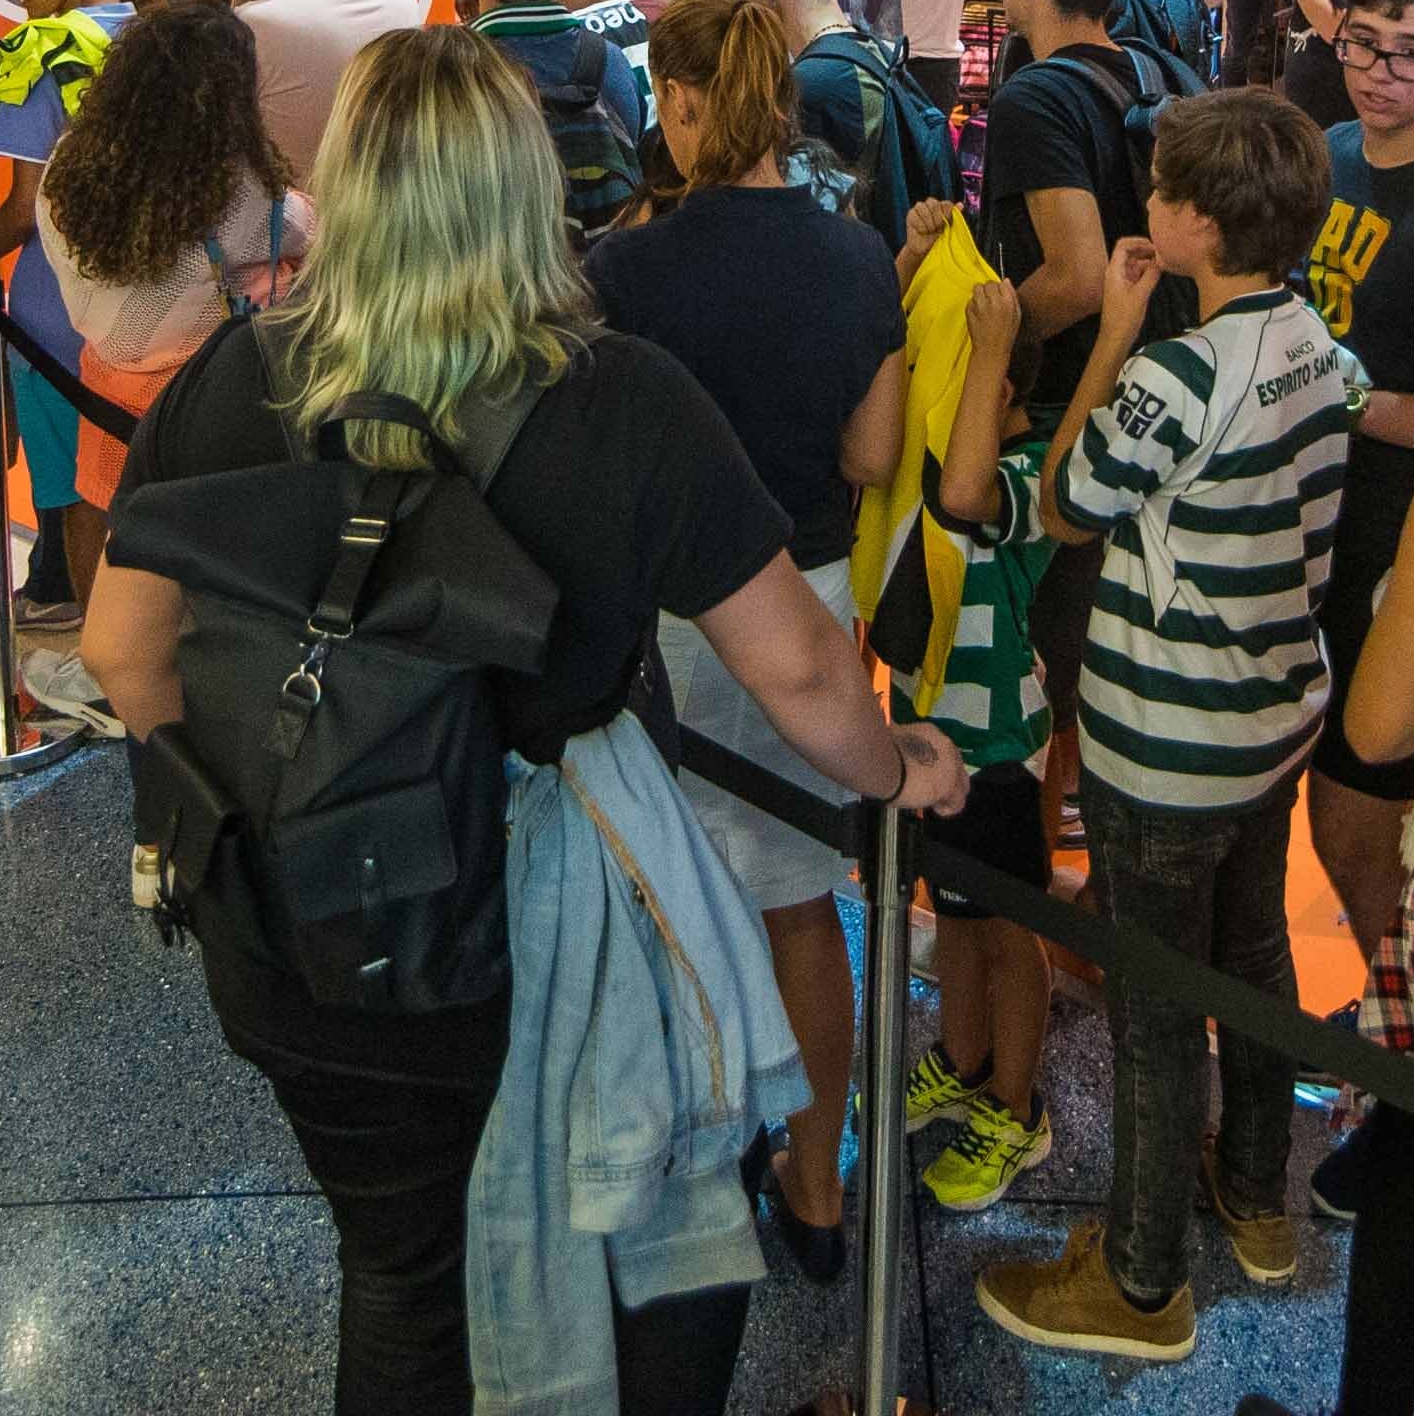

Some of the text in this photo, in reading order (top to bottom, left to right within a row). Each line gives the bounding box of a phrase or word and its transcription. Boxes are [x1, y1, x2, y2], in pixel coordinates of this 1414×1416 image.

[1285, 340, 1316, 364] BANCO
[1255, 348, 1339, 409] ESPIRITO SANT
